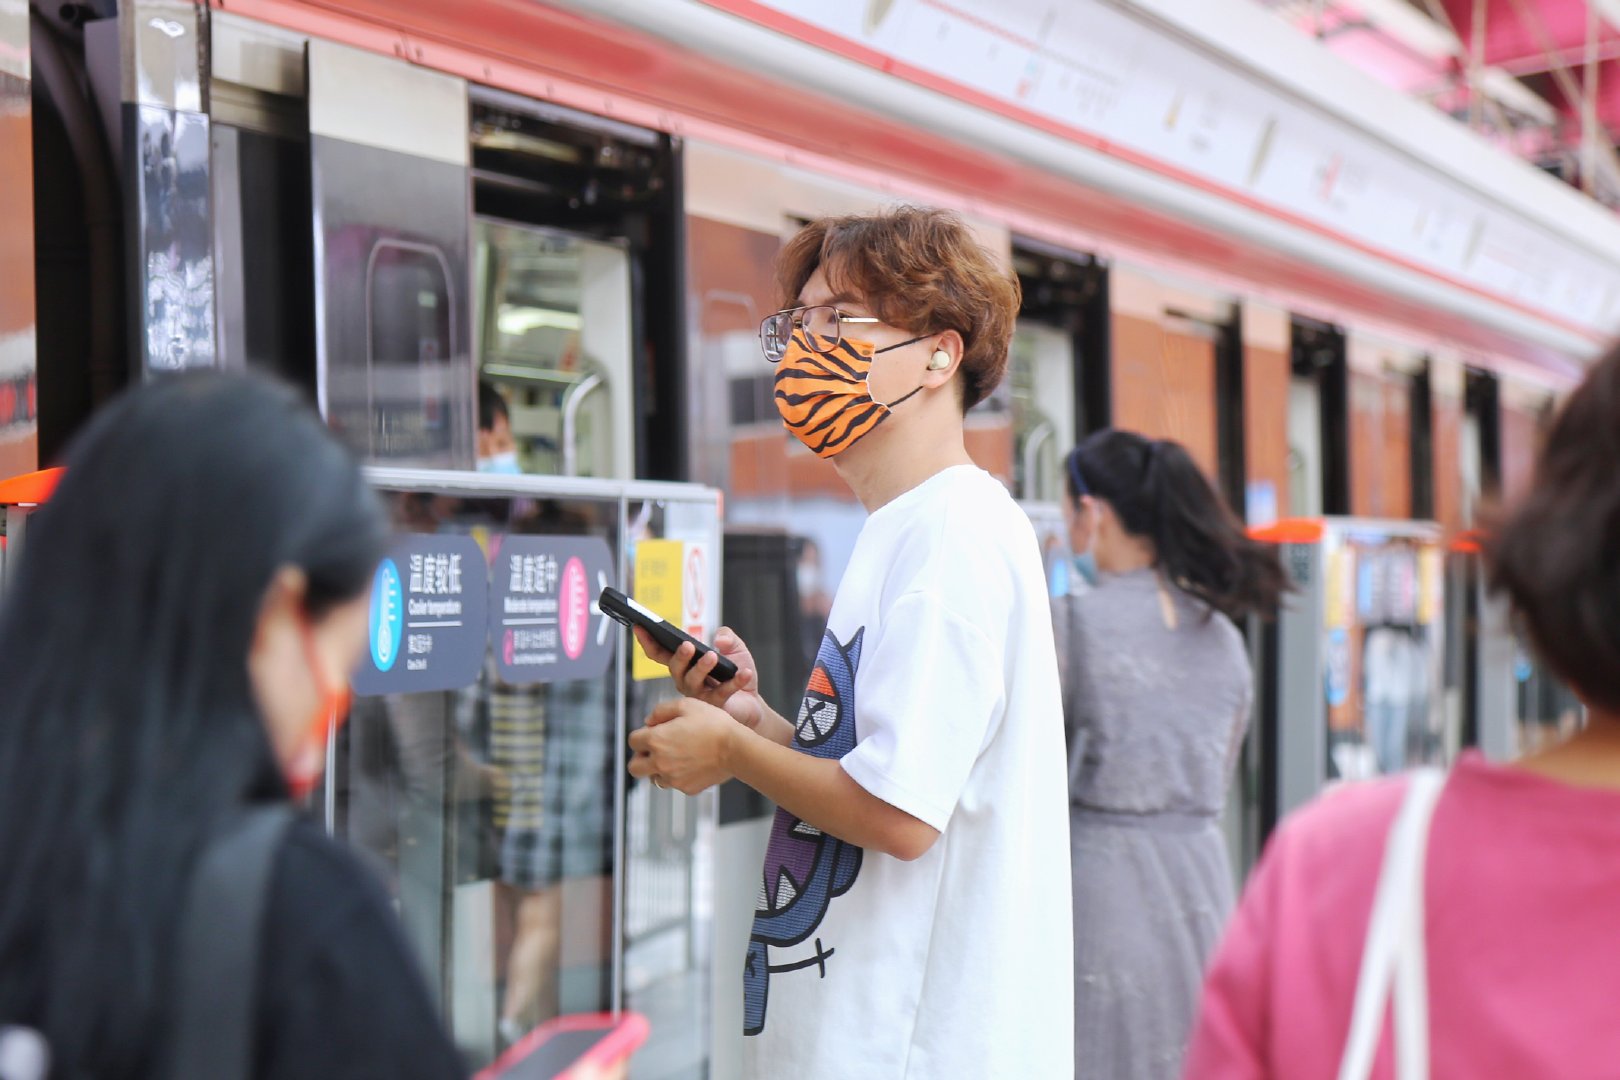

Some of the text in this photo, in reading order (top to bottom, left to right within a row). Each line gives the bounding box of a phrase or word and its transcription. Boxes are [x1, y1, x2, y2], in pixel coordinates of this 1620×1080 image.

[409, 553, 462, 594] 温度较低
[509, 553, 558, 593] 温度适中
